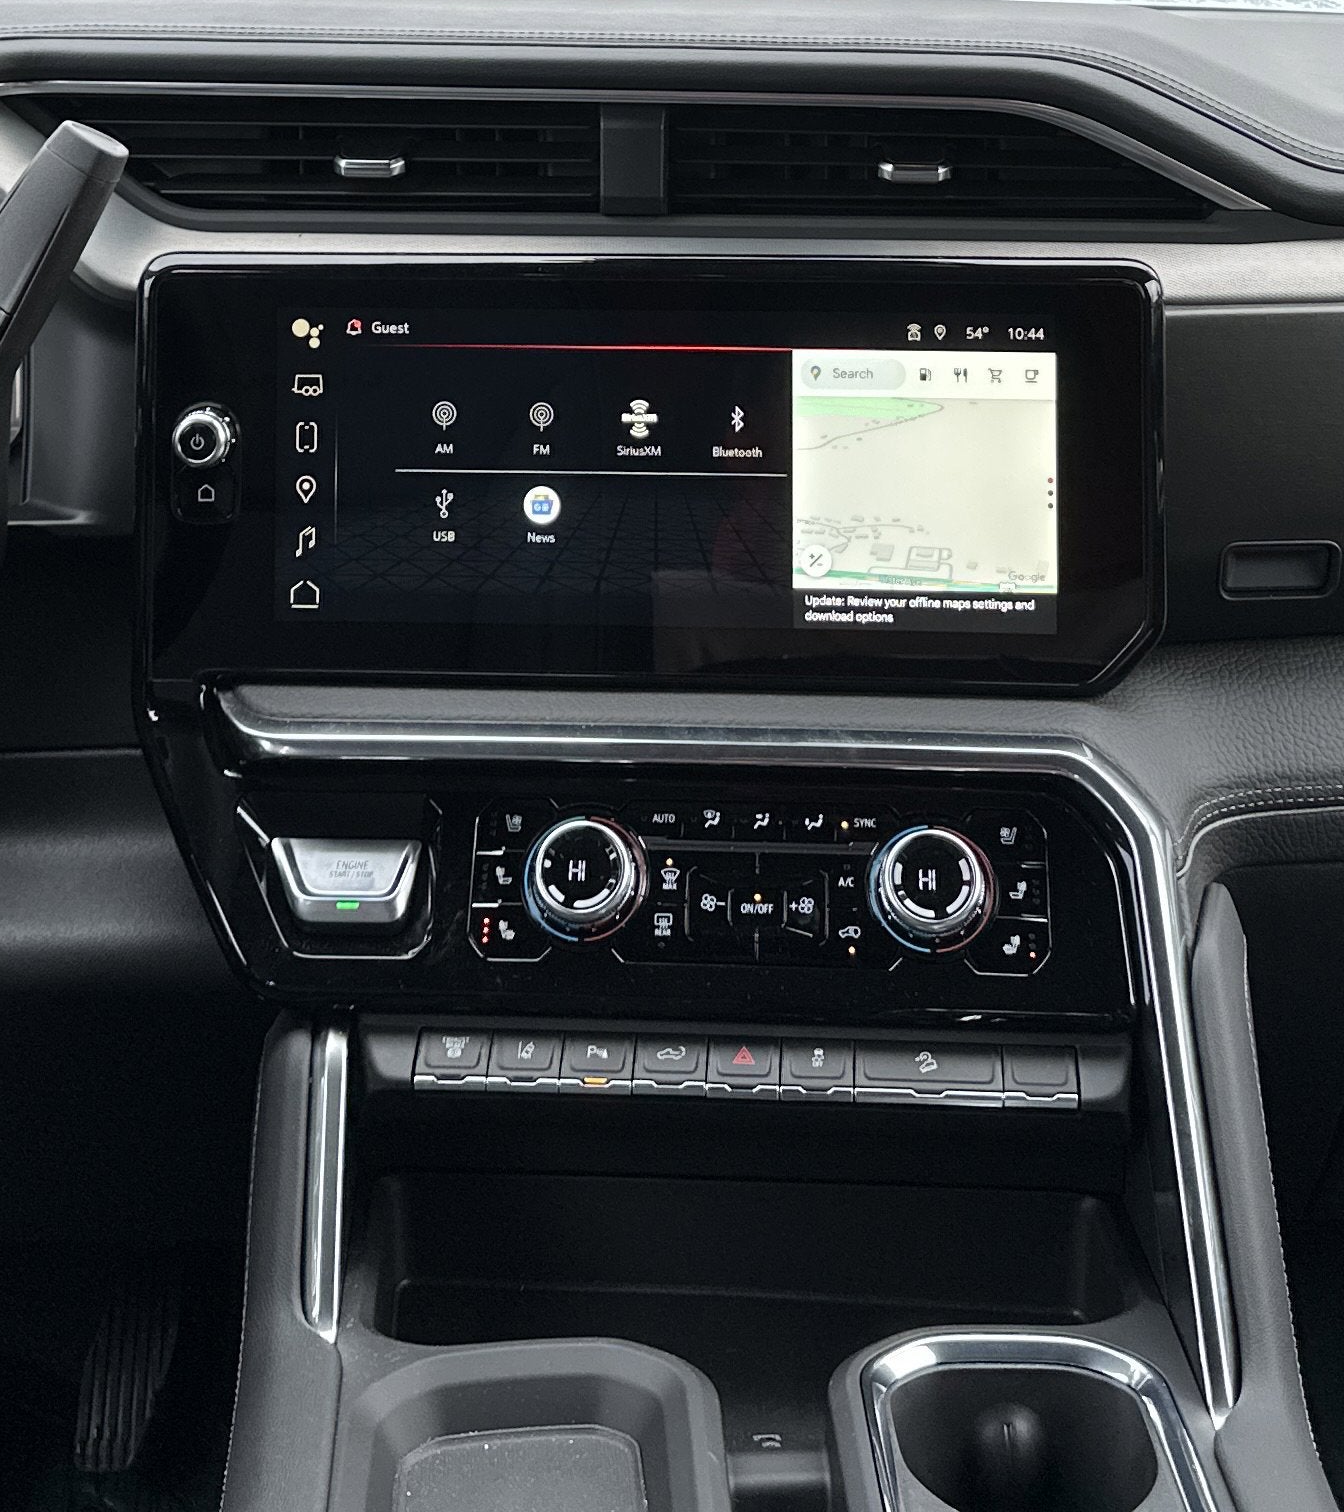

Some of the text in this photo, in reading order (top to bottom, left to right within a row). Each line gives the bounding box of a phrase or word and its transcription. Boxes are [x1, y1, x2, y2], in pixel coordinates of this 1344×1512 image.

[371, 321, 409, 335] Guest
[965, 325, 1045, 340] 54° 10:44
[832, 367, 874, 380] Search
[434, 443, 454, 455] AM
[532, 444, 551, 456] FM
[616, 445, 662, 457] SiriusXM
[712, 445, 763, 459] Bluetooth
[432, 531, 456, 543] USB
[527, 531, 556, 544] News
[1007, 570, 1046, 583] Google
[804, 594, 1035, 612] Update: Review your offline maps settings and
[804, 609, 894, 624] download options
[652, 813, 676, 824] AUTO
[853, 817, 877, 828] SYNC
[336, 860, 369, 871] ENGINE
[568, 859, 586, 882] HI
[837, 876, 855, 888] A/C
[917, 869, 938, 892] HI
[740, 903, 774, 914] ON/OFF
[654, 928, 672, 937] REAR
